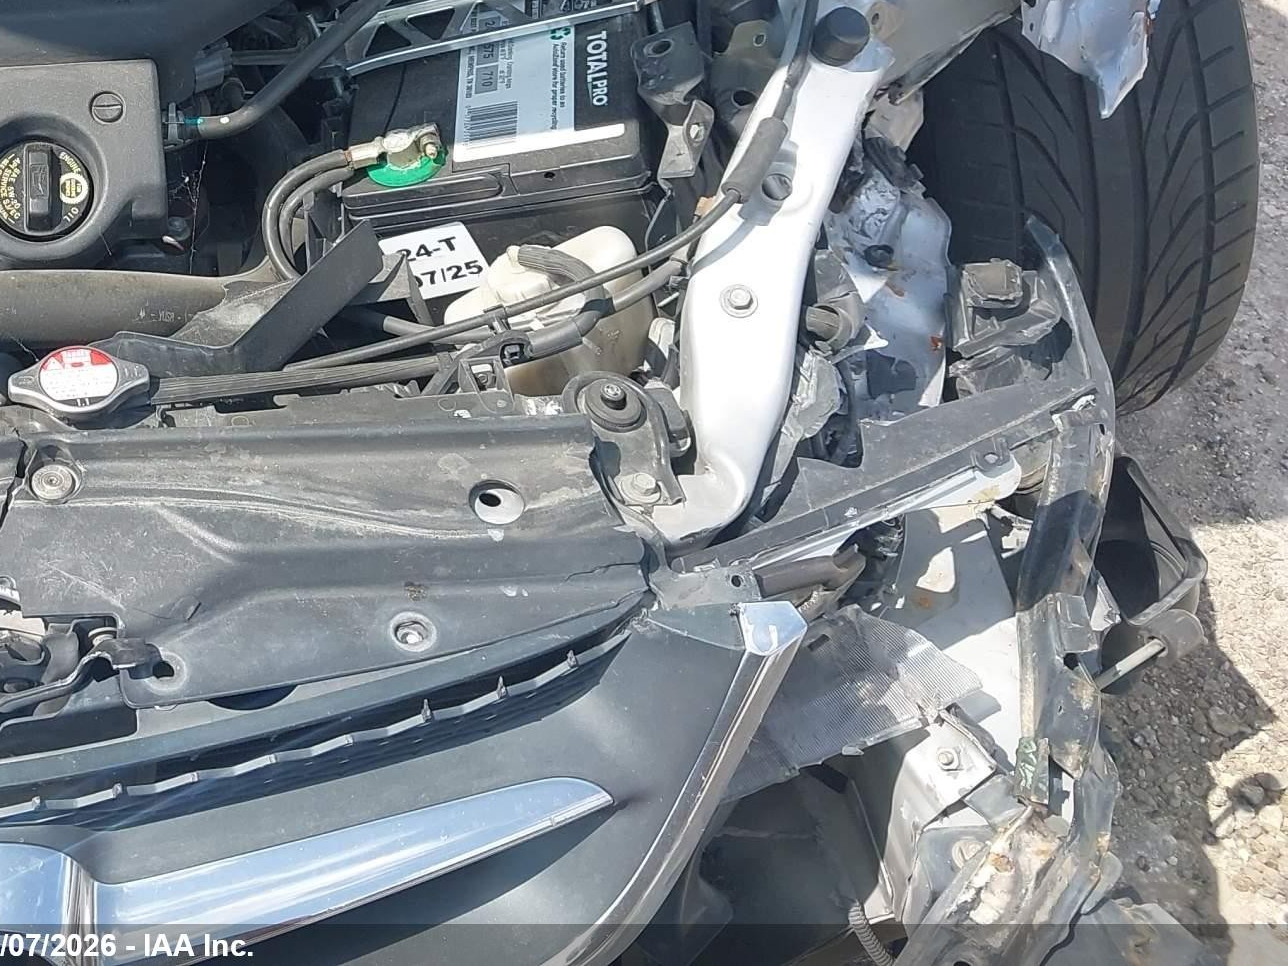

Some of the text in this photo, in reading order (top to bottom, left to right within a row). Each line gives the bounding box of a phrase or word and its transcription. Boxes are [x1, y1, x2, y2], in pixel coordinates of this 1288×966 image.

[483, 43, 494, 59] 575
[481, 70, 494, 87] 710
[63, 207, 79, 222] OIL
